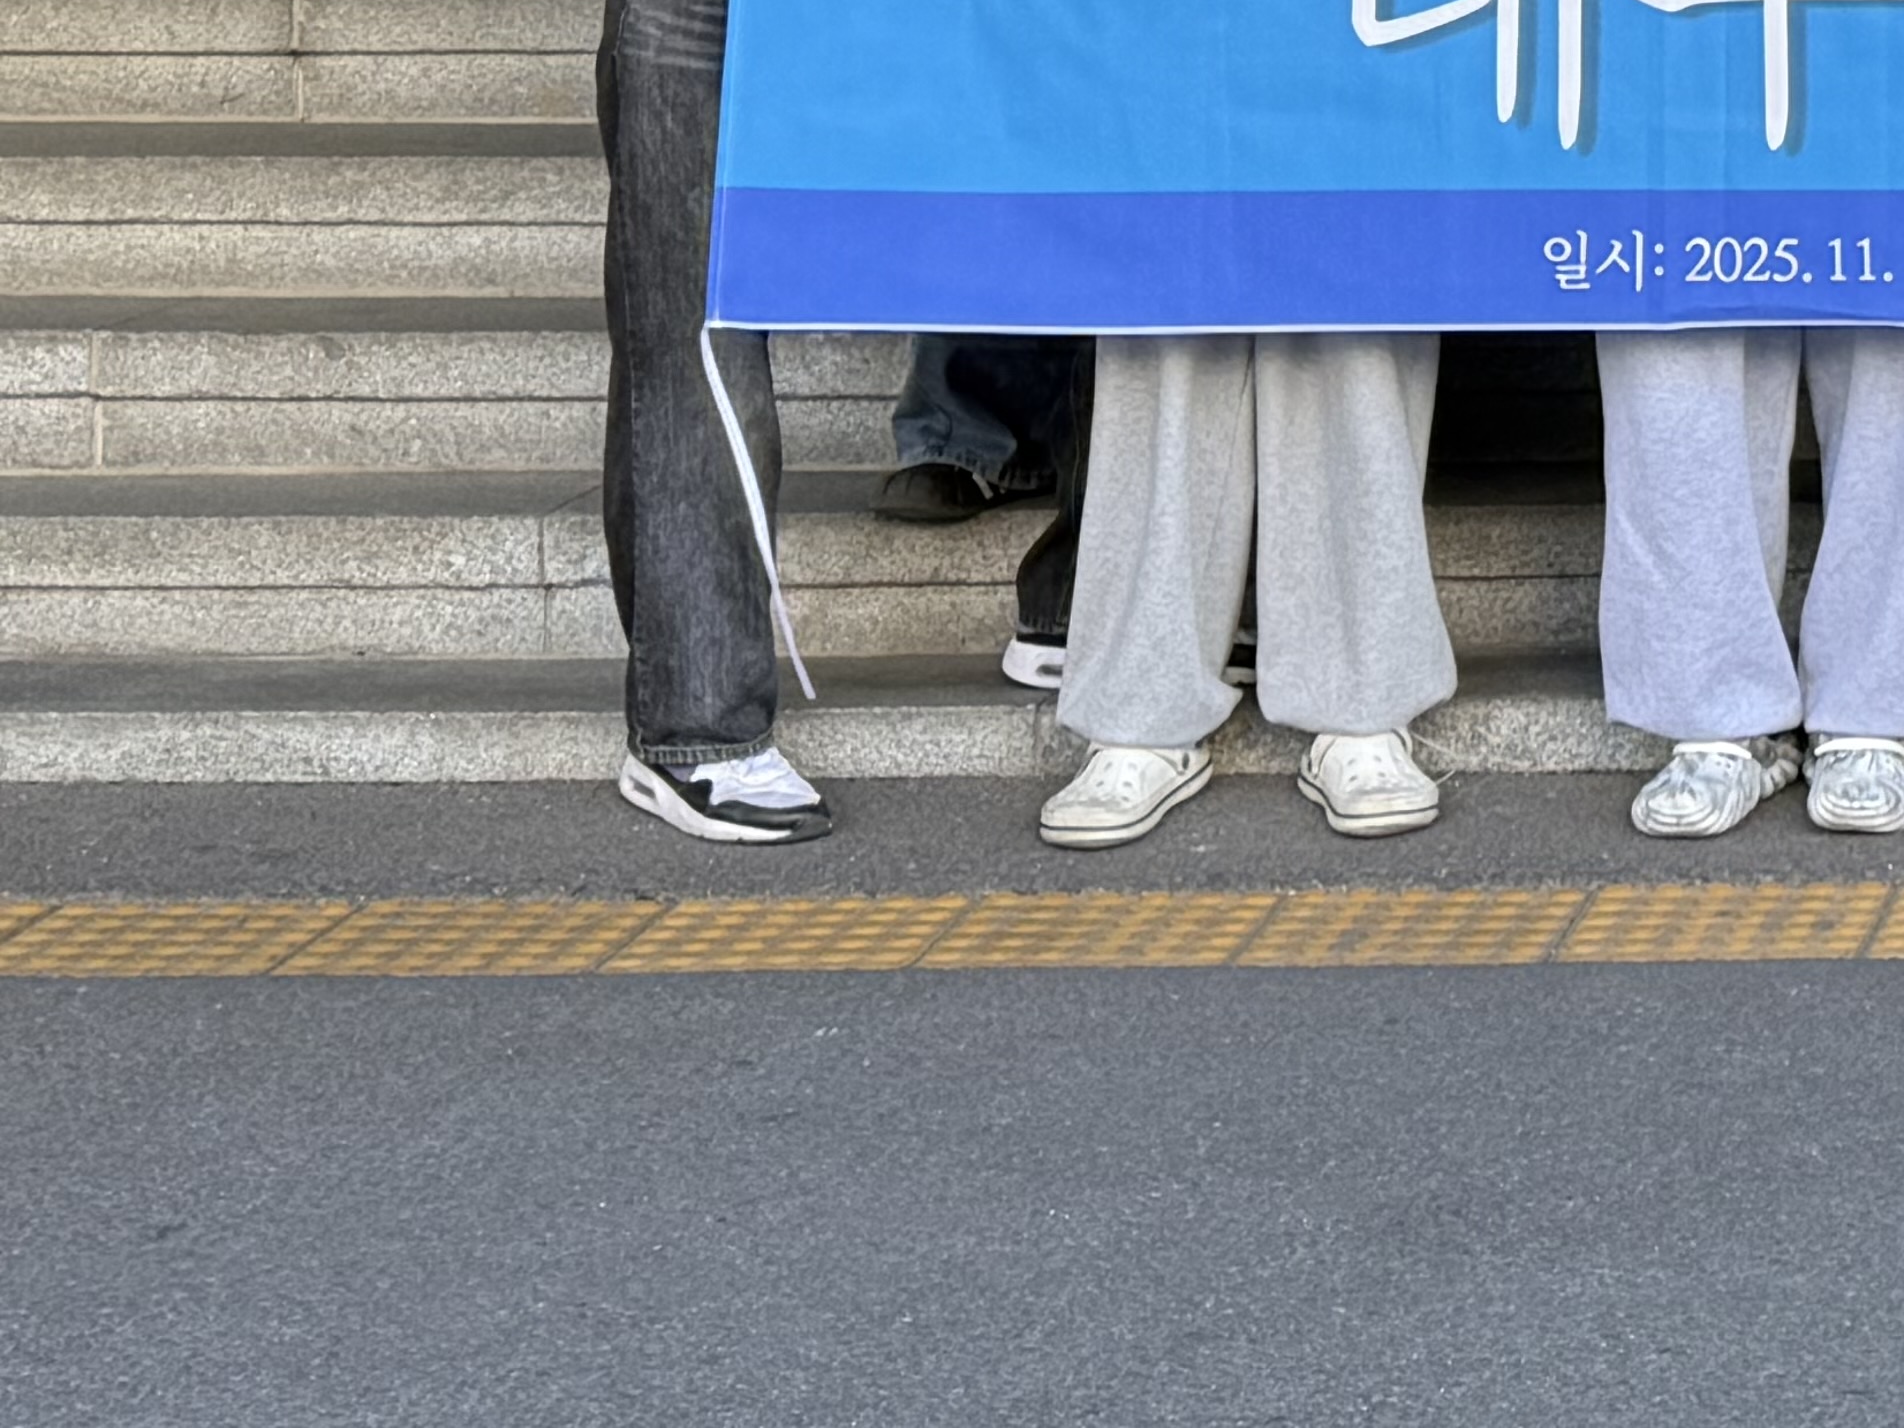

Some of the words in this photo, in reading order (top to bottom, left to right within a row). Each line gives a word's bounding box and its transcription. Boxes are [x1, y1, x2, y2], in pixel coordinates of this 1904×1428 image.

[1543, 229, 1665, 293] 일시:
[1685, 237, 1814, 284] 2025.
[1828, 238, 1894, 283] 11.
